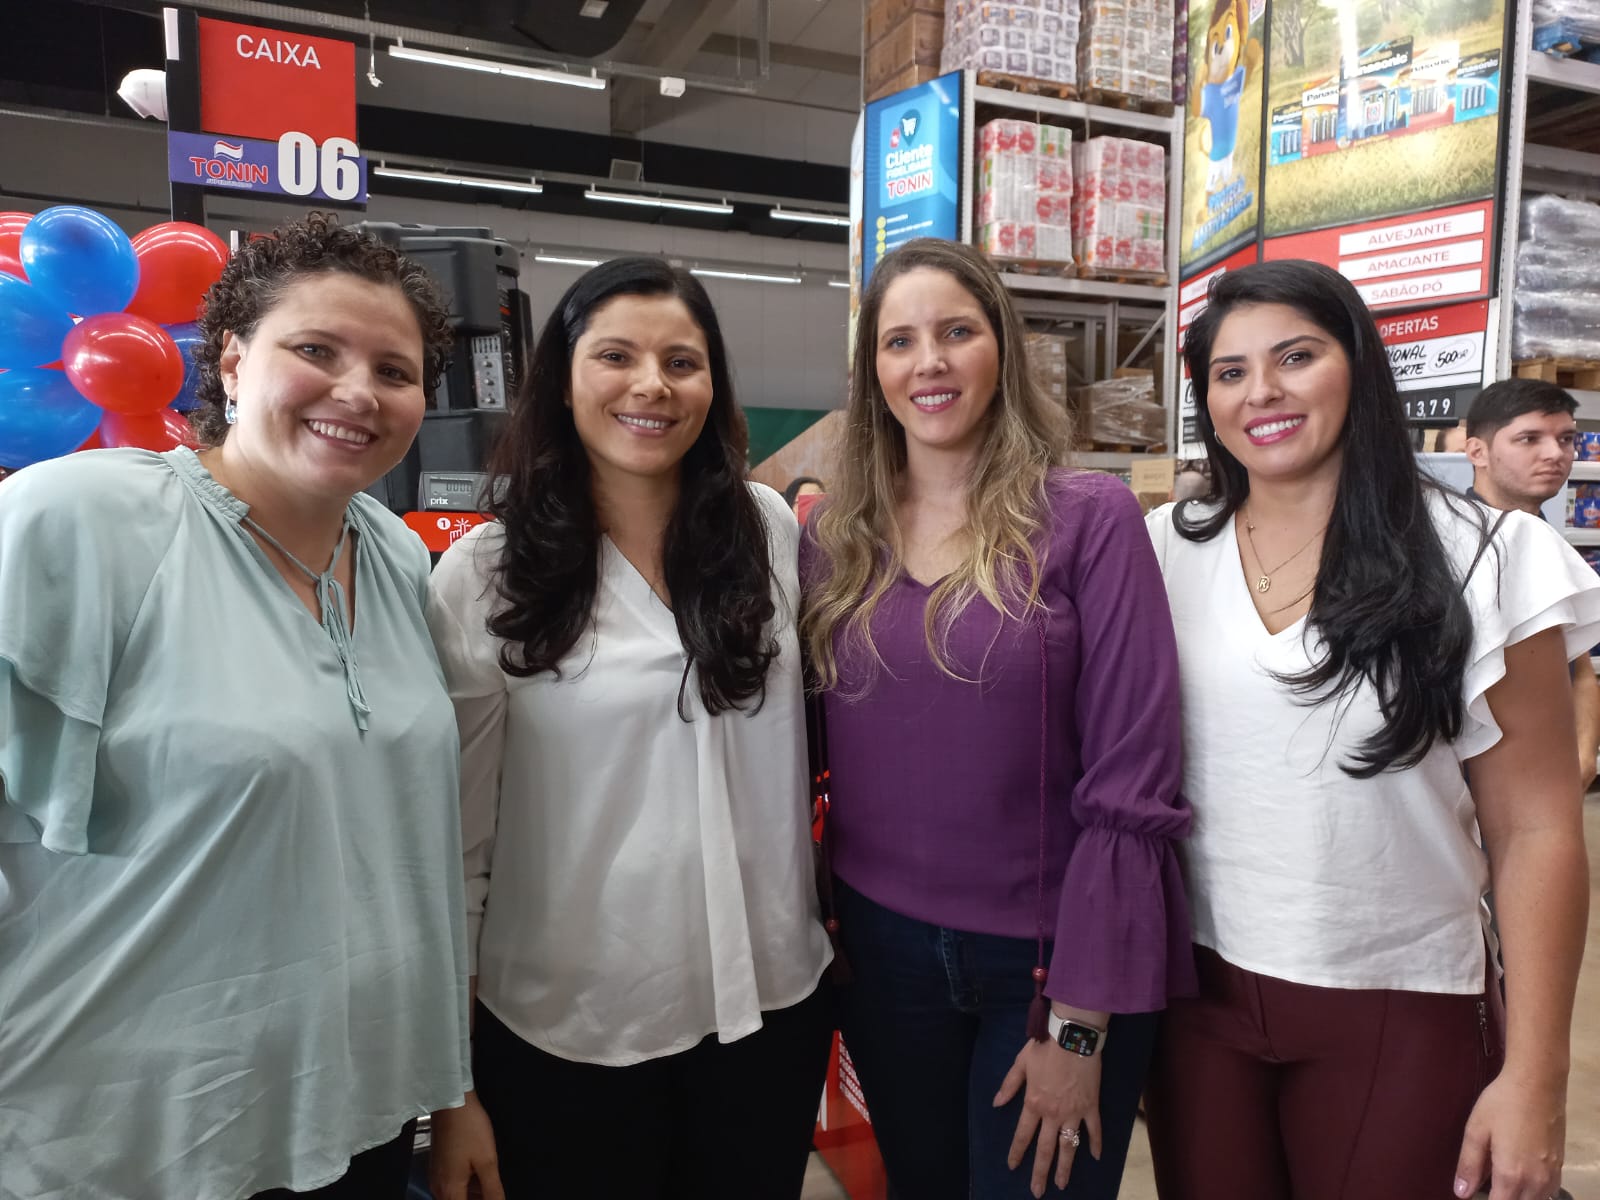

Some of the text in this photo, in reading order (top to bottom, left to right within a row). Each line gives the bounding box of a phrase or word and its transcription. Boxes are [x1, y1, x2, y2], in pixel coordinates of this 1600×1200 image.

[236, 34, 321, 70] CAIXA
[278, 131, 360, 201] 06
[886, 143, 934, 169] Cliente
[189, 156, 269, 184] TONIN
[887, 169, 933, 200] TONIN
[1368, 221, 1453, 246] ALVEJANTE
[1367, 250, 1450, 273] AMACIANTE
[1422, 279, 1443, 294] PÓ
[1380, 315, 1439, 338] OFERTAS
[430, 497, 449, 506] prix
